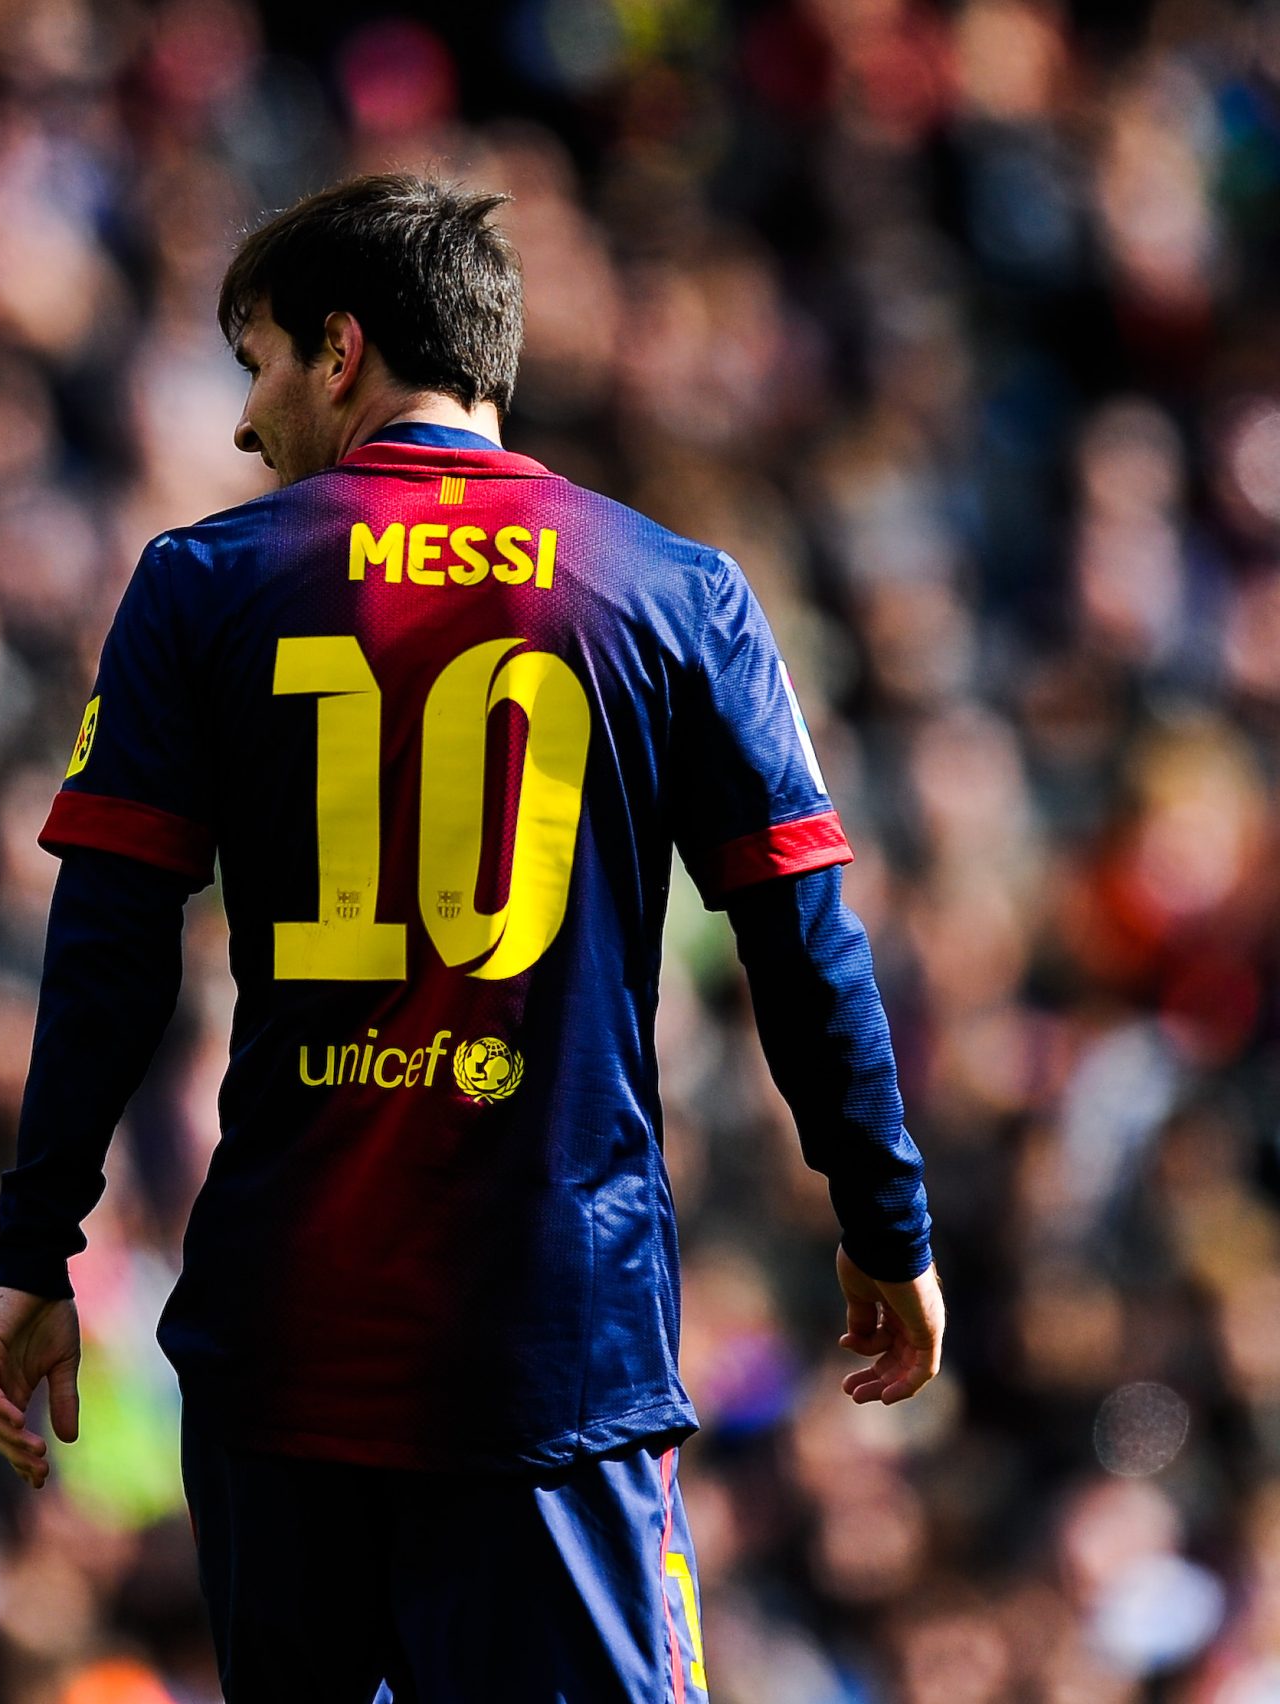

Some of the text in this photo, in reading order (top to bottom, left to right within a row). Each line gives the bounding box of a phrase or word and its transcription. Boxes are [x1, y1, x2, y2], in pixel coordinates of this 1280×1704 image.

[348, 521, 558, 589] MESSI
[272, 635, 591, 982] 10
[299, 1028, 452, 1089] unicef
